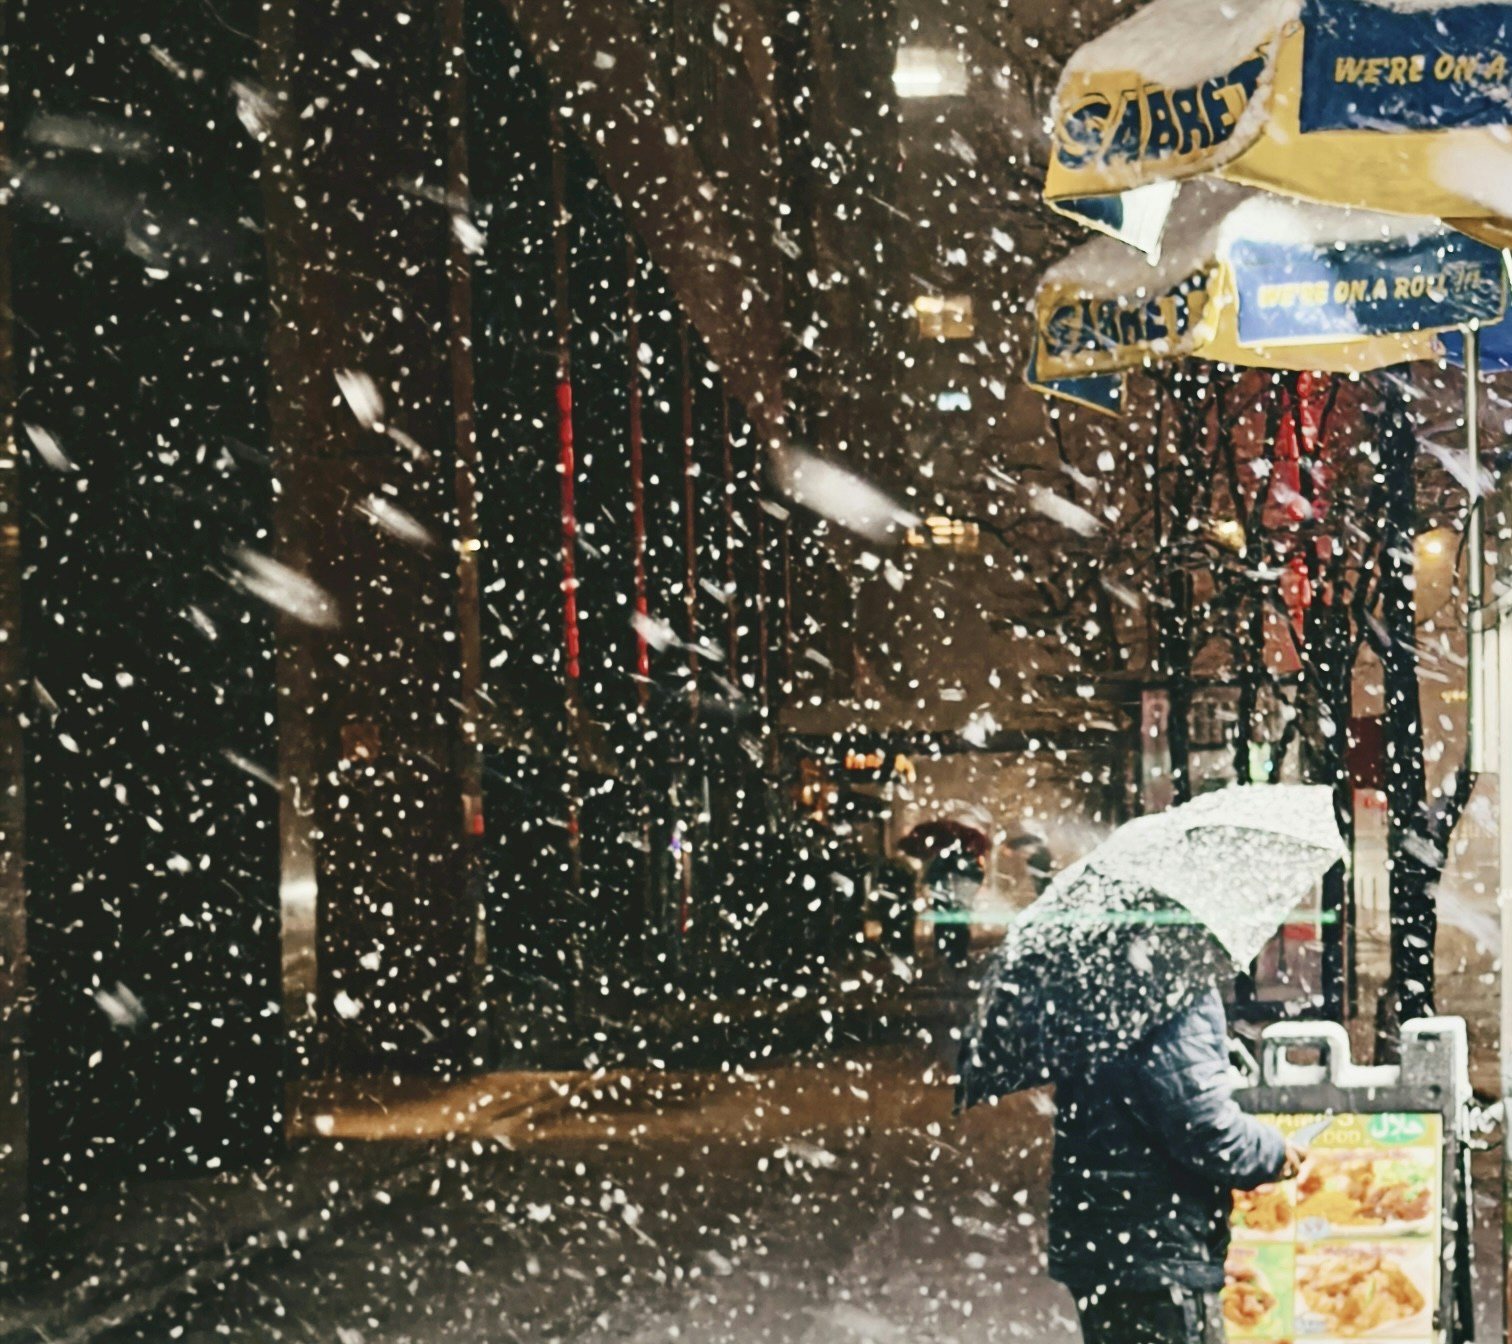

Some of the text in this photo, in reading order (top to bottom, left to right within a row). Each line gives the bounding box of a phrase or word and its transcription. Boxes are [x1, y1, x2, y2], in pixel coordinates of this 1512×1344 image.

[1434, 53, 1478, 83] ON
[1483, 52, 1507, 80] A
[1057, 43, 1267, 170] SABRET
[1334, 279, 1368, 304] ON
[1372, 277, 1388, 300] A
[1394, 272, 1448, 300] ROLL
[1314, 1129, 1362, 1144] OOD
